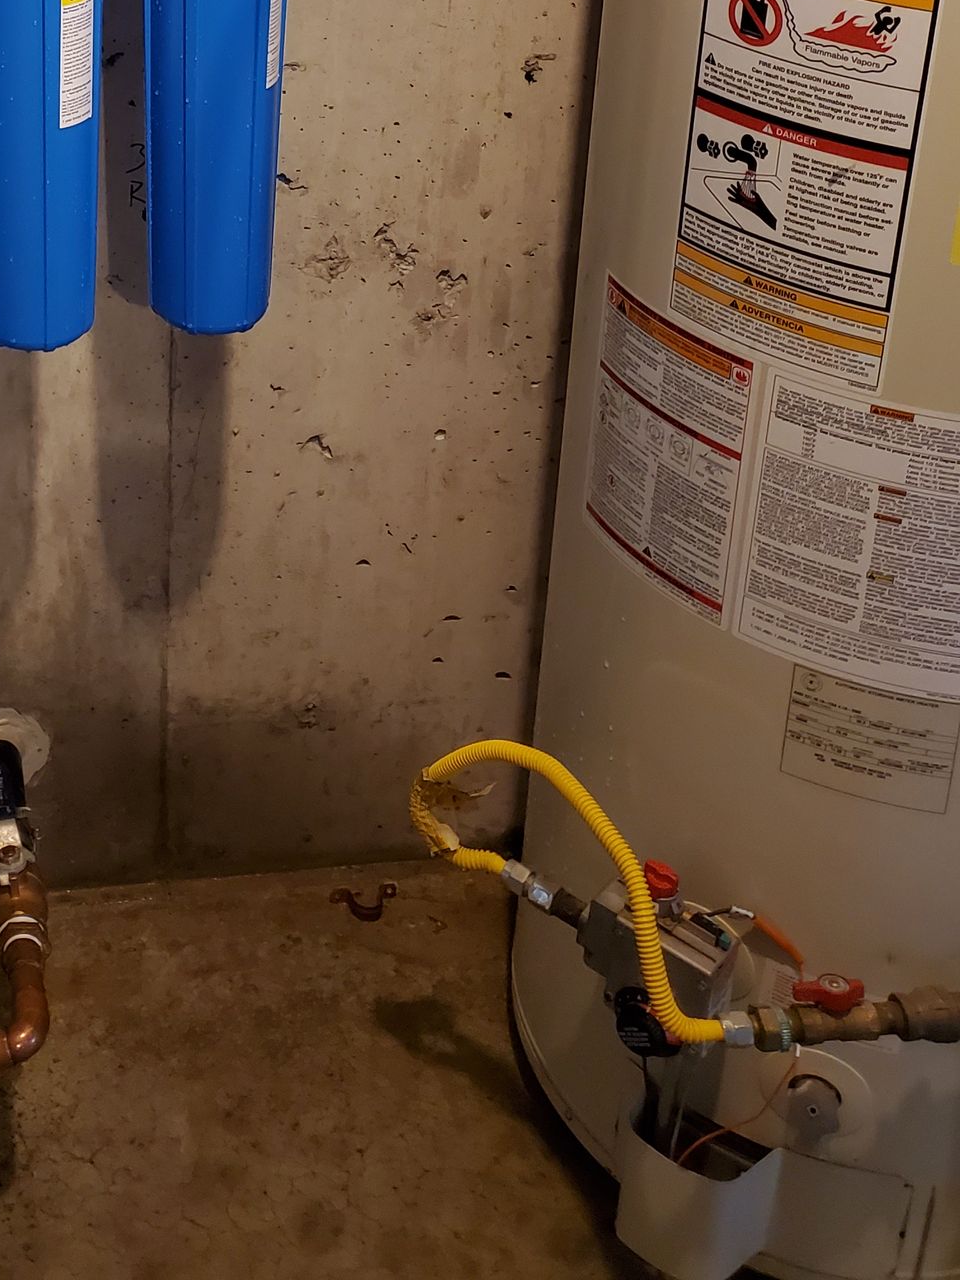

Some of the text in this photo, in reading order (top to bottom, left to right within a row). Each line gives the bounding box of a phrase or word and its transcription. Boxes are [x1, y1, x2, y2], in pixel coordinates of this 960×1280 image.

[805, 45, 881, 69] Flammable Vapors
[759, 60, 850, 90] FIRE AND EXPLOSION HAZARD
[764, 71, 779, 79] result
[787, 80, 808, 88] serious
[809, 84, 826, 94] injury
[836, 92, 853, 100] death
[719, 71, 735, 81] vicinity
[761, 86, 770, 94] any
[772, 89, 786, 98] other
[788, 95, 816, 106] appliance.
[819, 102, 842, 114] Storage
[881, 119, 908, 128] gasoline
[766, 81, 788, 91] gasoline
[797, 90, 813, 98] other
[814, 95, 845, 106] flammable
[847, 103, 868, 112] vapors
[884, 111, 906, 119] liquids
[776, 128, 817, 146] DANGER
[791, 167, 808, 176] death
[809, 172, 823, 180] from
[792, 161, 810, 169] cause
[811, 166, 831, 175] severe
[833, 172, 851, 180] burns
[852, 176, 880, 189] instantly
[793, 153, 810, 161] Water
[811, 159, 848, 173] temperature
[790, 177, 816, 190] Children,
[818, 186, 844, 197] disabled
[859, 197, 881, 206] elderly
[796, 187, 818, 197] highest
[819, 193, 831, 201] risk
[840, 199, 858, 208] being
[860, 204, 886, 214] scalded.
[785, 209, 798, 217] Feel
[799, 214, 815, 222] water
[817, 219, 836, 228] before
[838, 225, 862, 236] bathing
[786, 200, 798, 208] ting
[800, 204, 836, 219] temperature
[864, 221, 885, 231] heater.
[800, 197, 832, 210] instruction
[834, 207, 857, 217] manual
[859, 212, 879, 222] before
[784, 217, 816, 231] showering.
[782, 232, 809, 245] available,
[823, 245, 848, 256] manual.
[783, 225, 820, 241] Temperature
[821, 237, 844, 248] limiting
[846, 244, 866, 253] valves
[755, 280, 797, 301] WARNING
[742, 305, 804, 333] ADVERTENCIA
